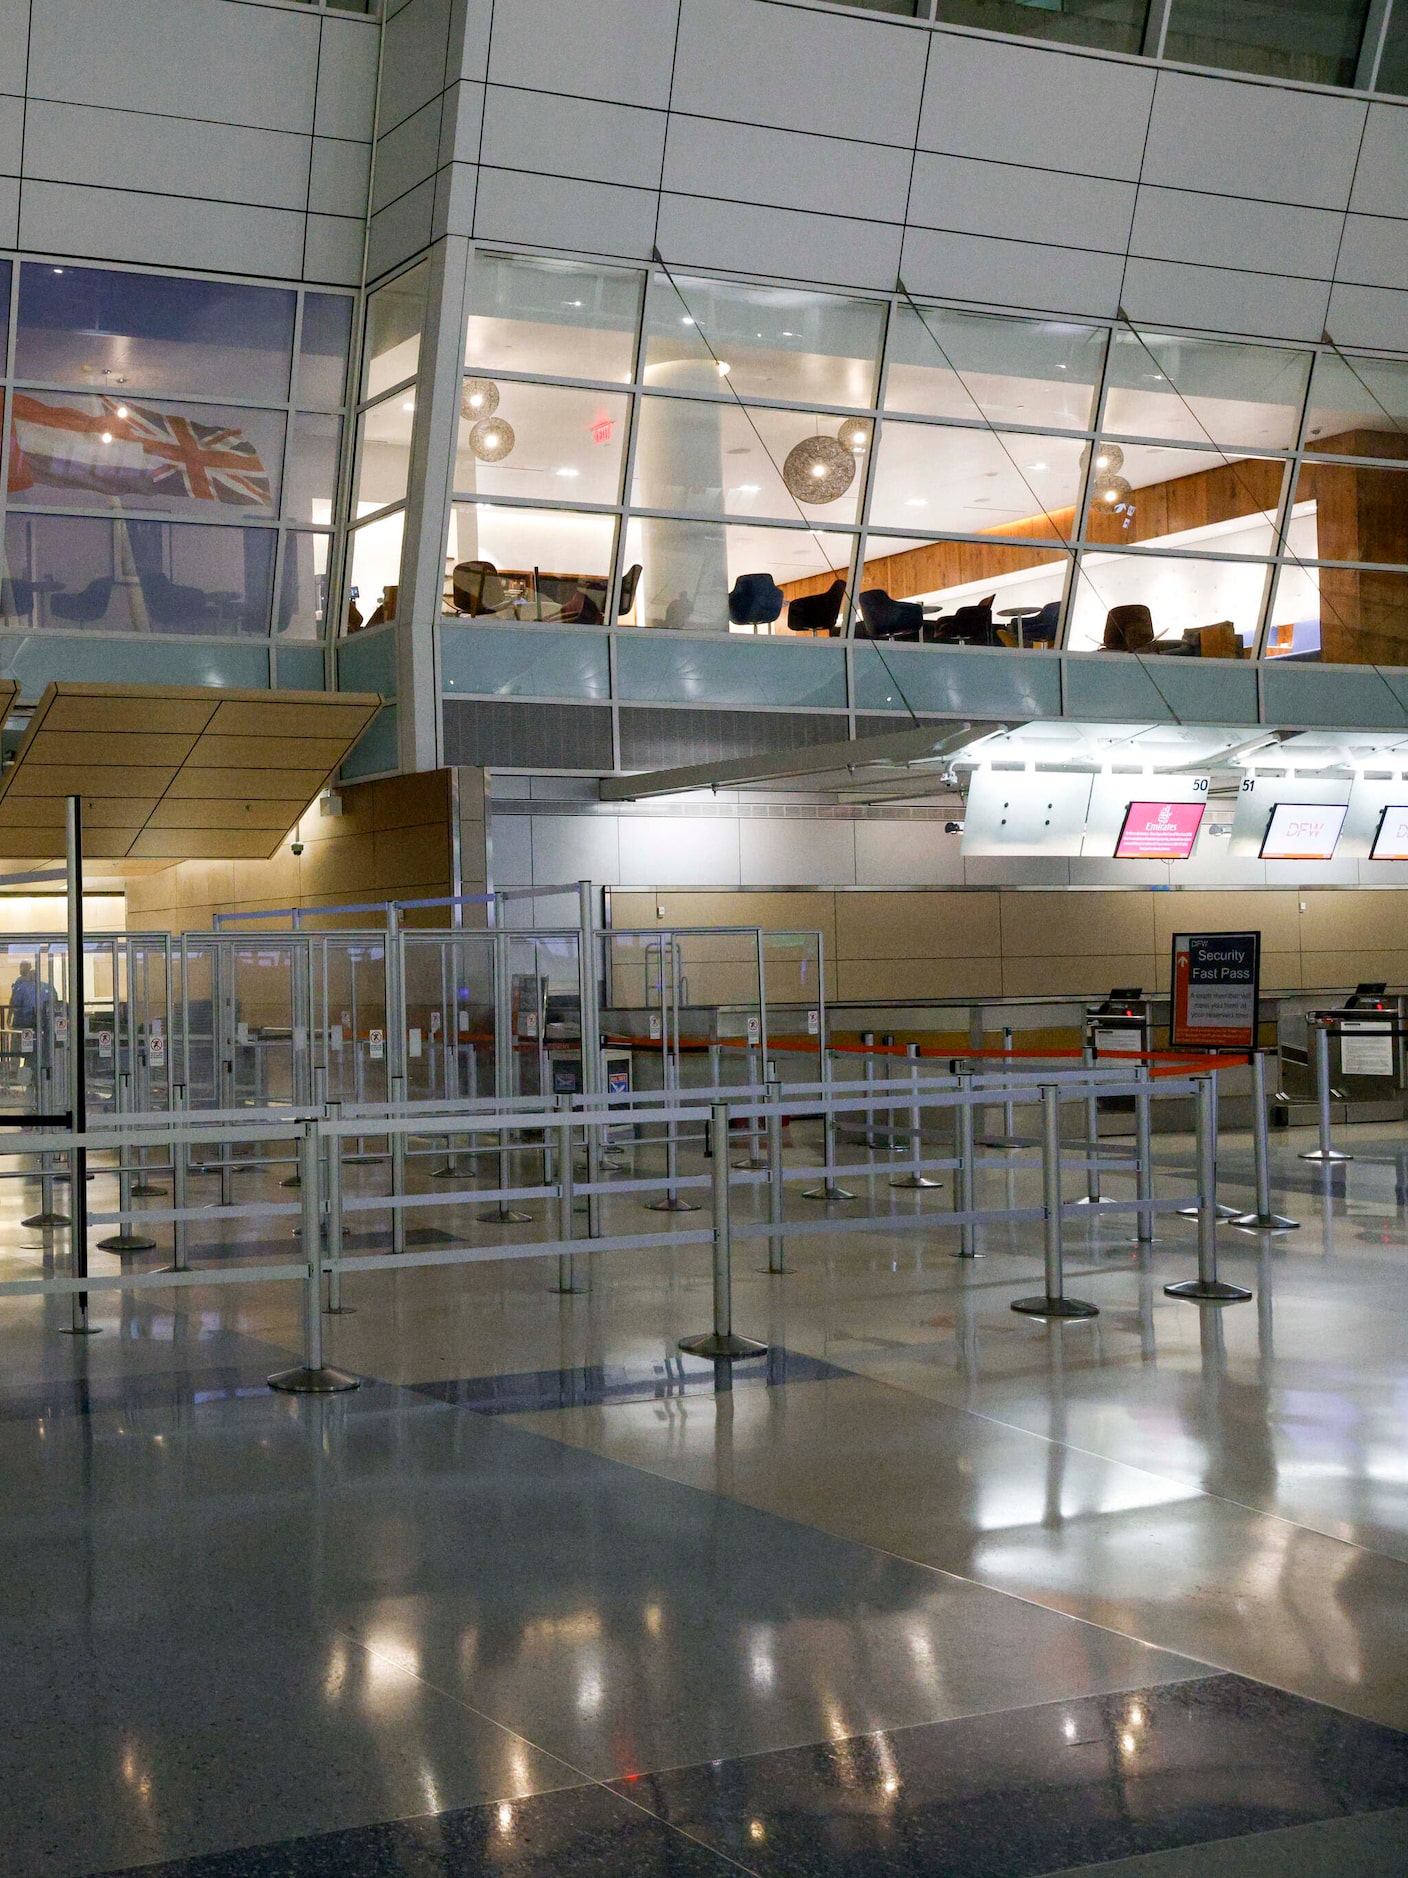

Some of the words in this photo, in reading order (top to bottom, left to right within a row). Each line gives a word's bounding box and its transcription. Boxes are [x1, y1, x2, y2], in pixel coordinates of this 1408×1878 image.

[1193, 779, 1208, 790] 50
[1242, 780, 1254, 791] 51
[1145, 822, 1178, 831] Emirates
[1287, 822, 1324, 837] DFW
[1198, 950, 1245, 963] Security
[1192, 968, 1218, 979] Fast
[1221, 968, 1250, 979] Pass
